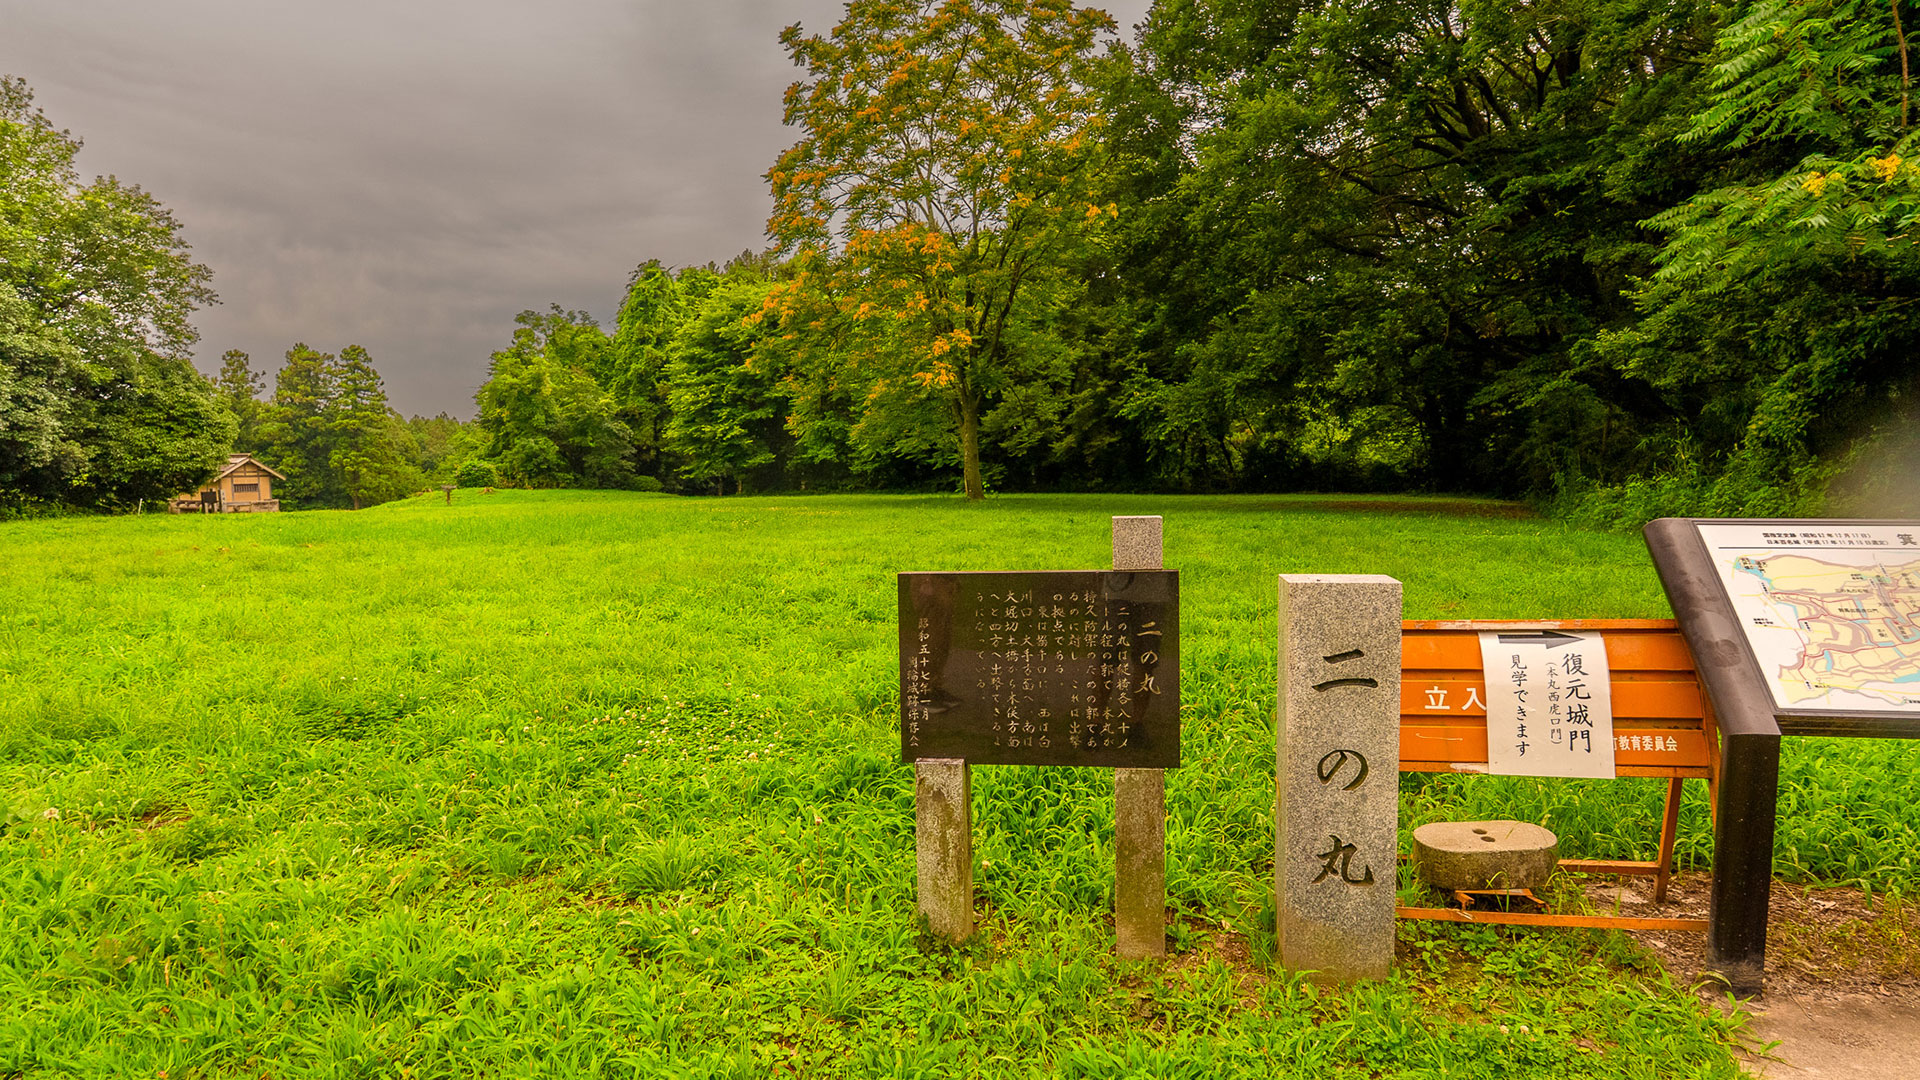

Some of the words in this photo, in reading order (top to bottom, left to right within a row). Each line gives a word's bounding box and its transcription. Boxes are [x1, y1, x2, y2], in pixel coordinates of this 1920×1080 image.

[917, 617, 932, 721] 昭和五十七年一月
[1134, 621, 1163, 695] 二の丸
[1510, 654, 1531, 758] 見学できます
[1561, 653, 1594, 754] 復元城門
[1311, 648, 1379, 887] 二の丸
